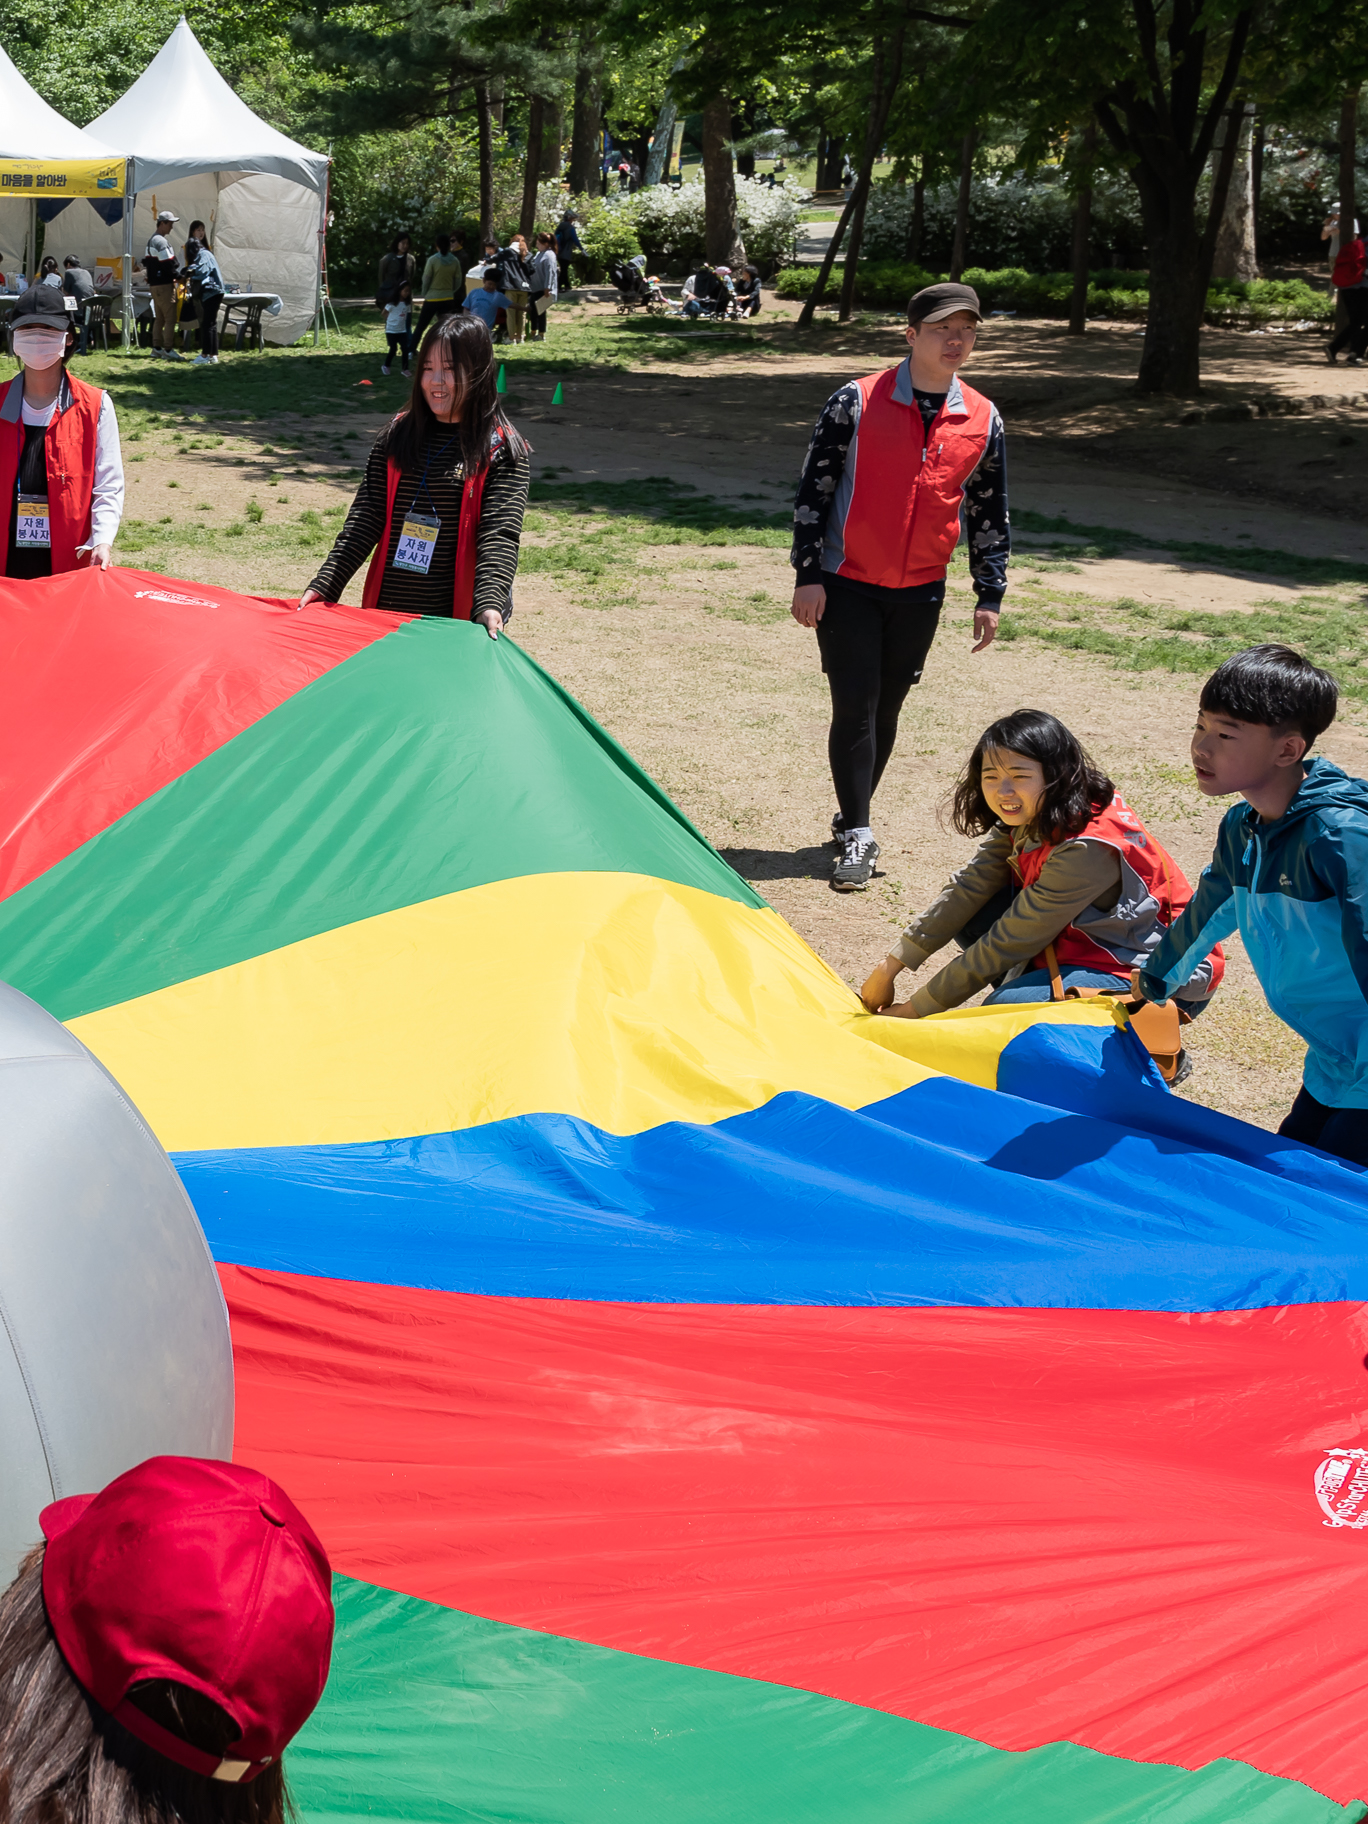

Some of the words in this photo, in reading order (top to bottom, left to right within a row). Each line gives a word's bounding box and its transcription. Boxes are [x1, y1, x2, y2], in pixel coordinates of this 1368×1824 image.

[2, 173, 33, 187] 마음을
[24, 517, 44, 528] 자원
[18, 528, 49, 540] 봉사자
[405, 537, 427, 552] 자원
[397, 548, 430, 566] 봉사자
